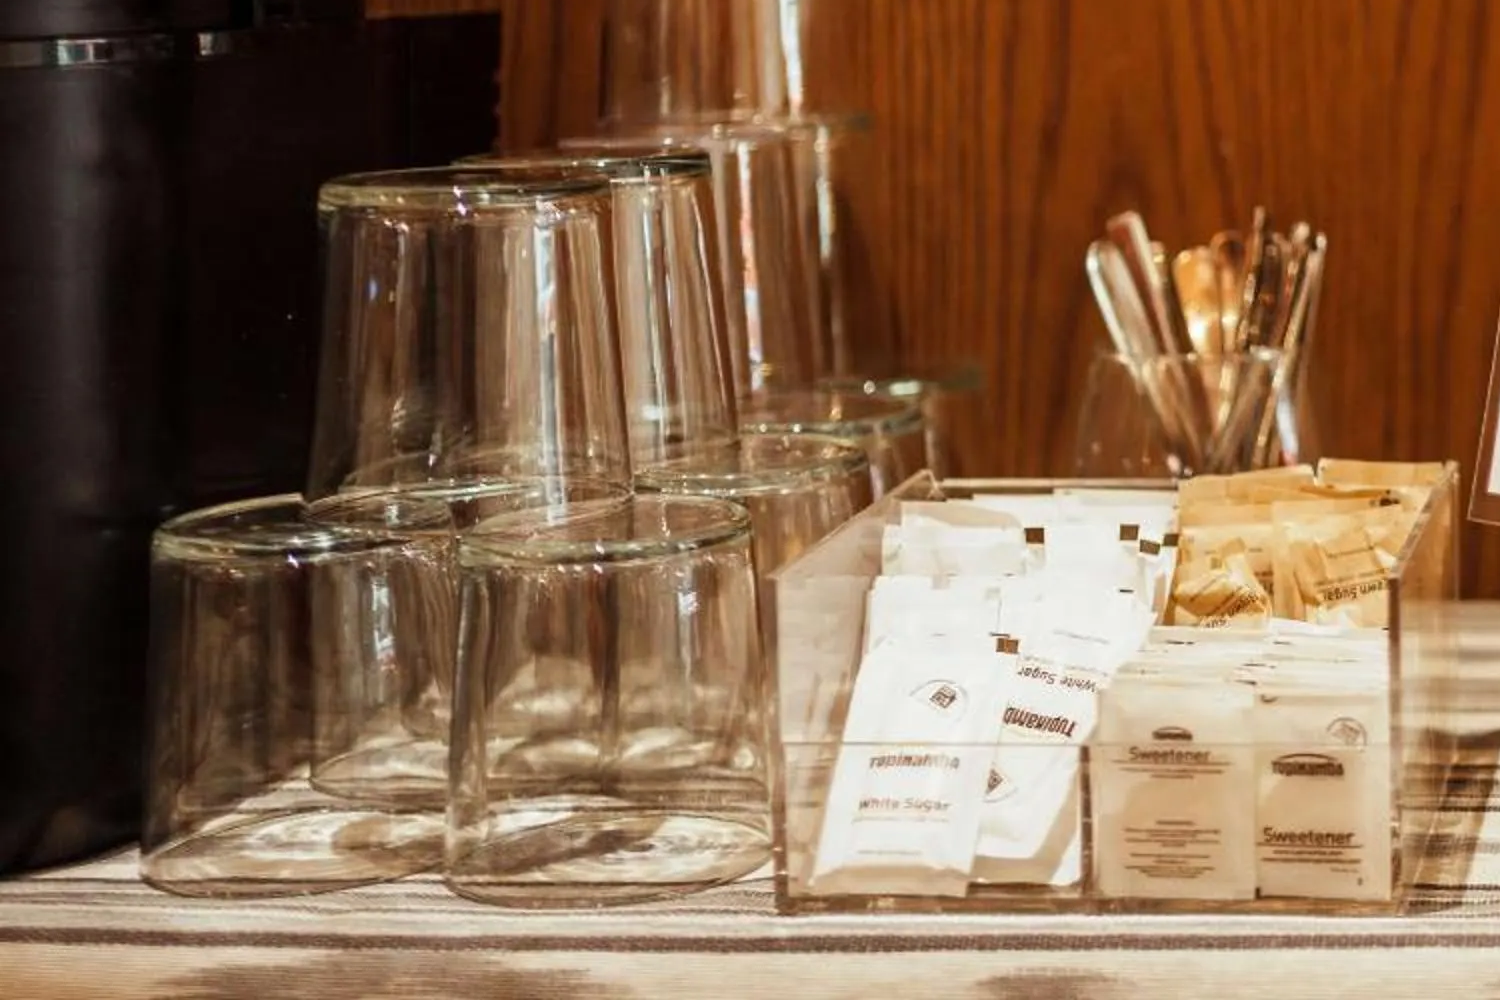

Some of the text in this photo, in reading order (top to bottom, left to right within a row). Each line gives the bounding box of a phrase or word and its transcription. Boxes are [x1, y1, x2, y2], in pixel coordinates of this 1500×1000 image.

[1016, 666, 1057, 685] Sugar
[1128, 746, 1211, 762] Sweetener
[1262, 826, 1356, 844] Sweetener
